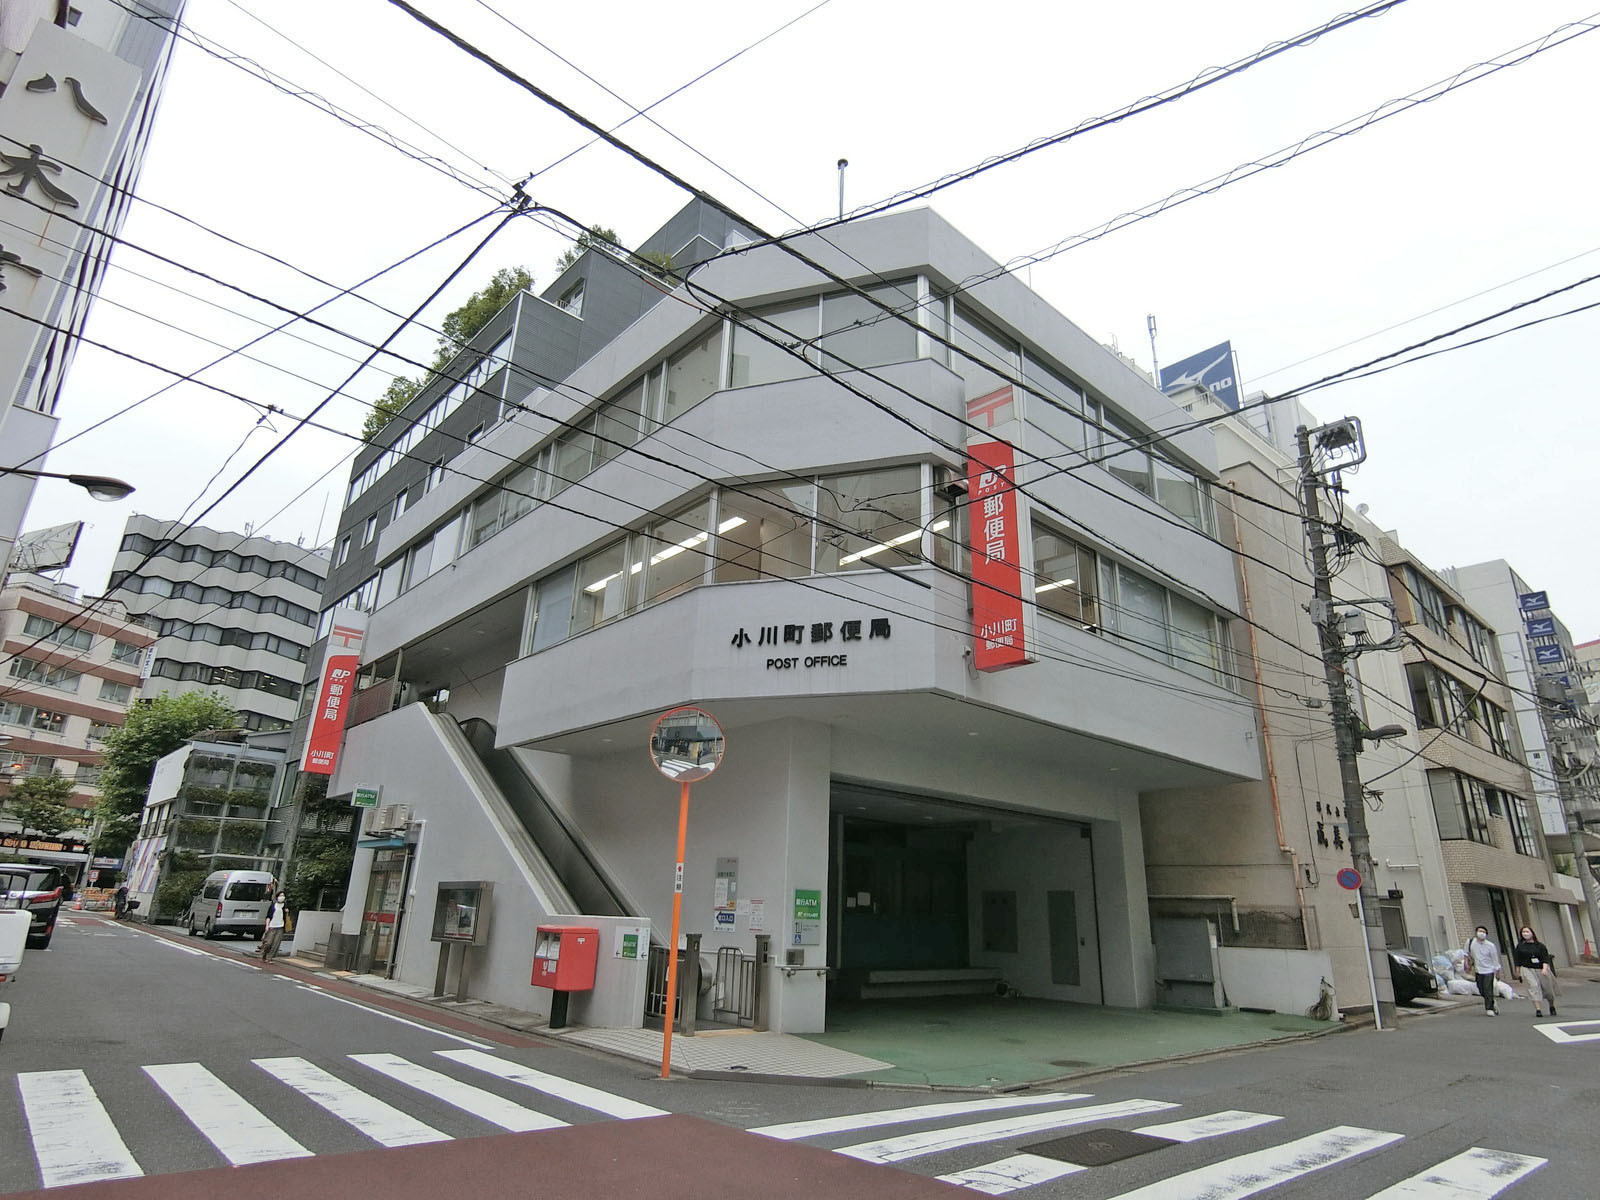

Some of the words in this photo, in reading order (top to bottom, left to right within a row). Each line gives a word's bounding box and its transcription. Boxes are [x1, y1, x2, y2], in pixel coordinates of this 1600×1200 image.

[983, 493, 1005, 565] 郵便局
[731, 618, 891, 648] 小川町郵便局
[980, 618, 1017, 638] 小川町
[766, 658, 799, 670] POST
[804, 655, 848, 668] OFFICE
[323, 684, 344, 721] 郵便局
[310, 750, 335, 759] 小川町
